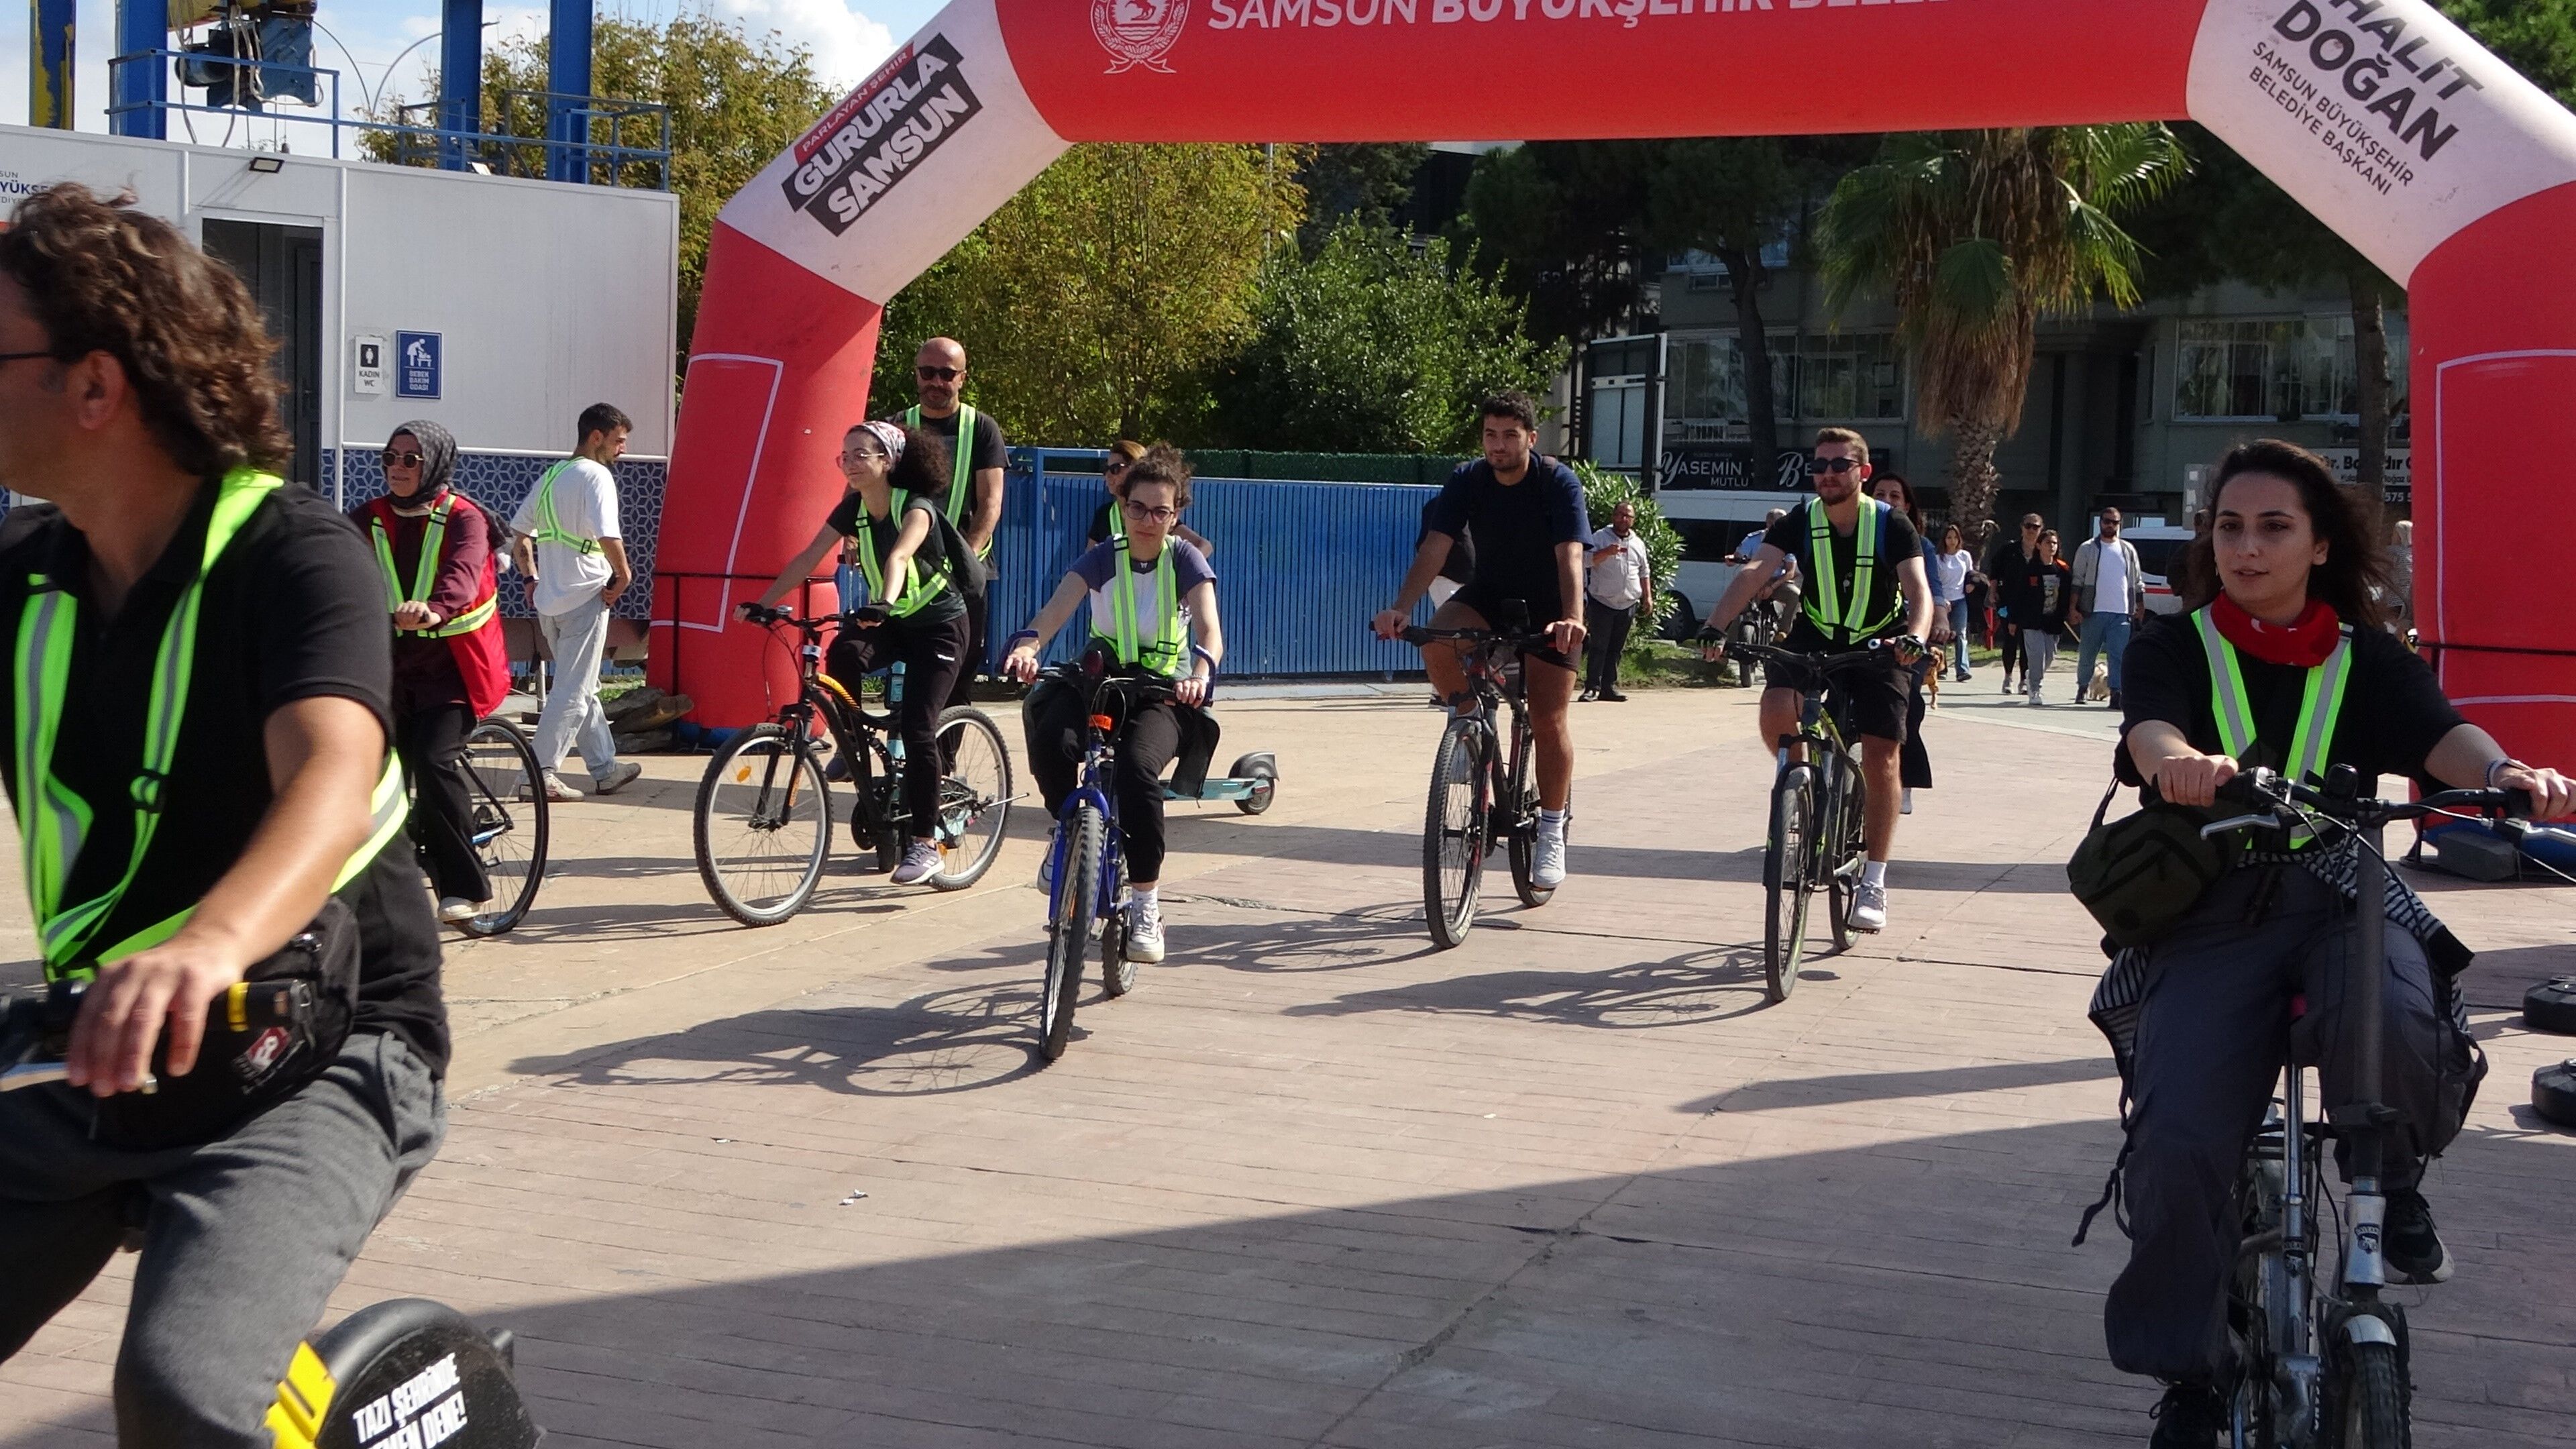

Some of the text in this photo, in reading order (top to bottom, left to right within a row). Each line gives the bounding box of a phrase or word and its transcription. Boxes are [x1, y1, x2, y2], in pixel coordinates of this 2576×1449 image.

[1208, 0, 1415, 29] SAMSUN
[794, 52, 949, 195] GURURLA
[801, 87, 869, 152] PARLAYAN
[2249, 66, 2393, 196] BELEDİYE BAŞKANI
[2253, 42, 2414, 187] SAMSUN BÜYÜKŞEHİR
[2273, 0, 2459, 162] DOĞAN
[828, 83, 969, 223] SAMSUN
[1710, 477, 1749, 487] MUTLU
[421, 1390, 468, 1449] DENE!
